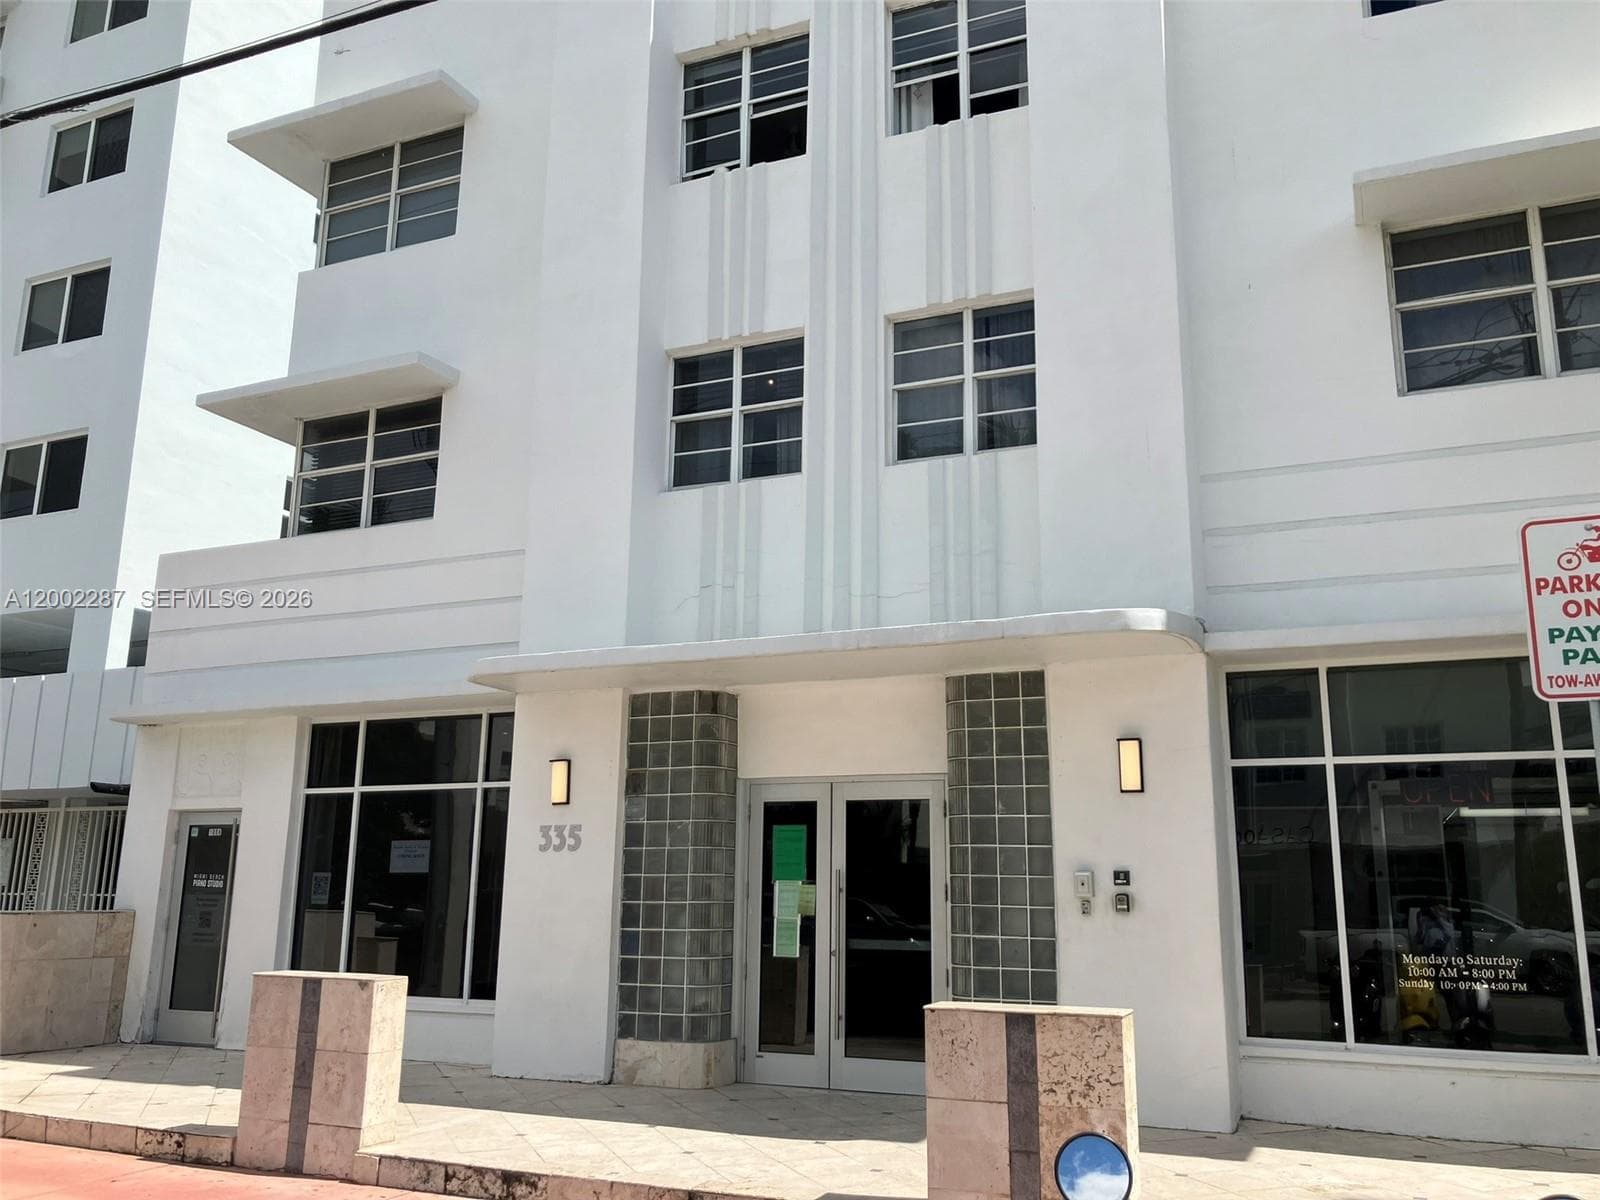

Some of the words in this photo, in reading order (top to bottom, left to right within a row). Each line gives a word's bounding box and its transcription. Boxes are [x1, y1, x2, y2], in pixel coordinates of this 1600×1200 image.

[1535, 573, 1600, 596] PARK
[1562, 598, 1600, 618] ON
[1548, 625, 1600, 644] PAY
[1562, 648, 1600, 666] PA
[538, 824, 582, 853] 335
[192, 879, 207, 887] PIANO
[207, 879, 224, 888] STUDIO
[1402, 953, 1448, 967] Monday
[1451, 955, 1464, 965] to
[1466, 954, 1523, 969] Saturday:
[1408, 966, 1436, 977] 10:00
[1438, 967, 1458, 978] AM
[1471, 968, 1495, 979] 8:00
[1498, 969, 1517, 980] PM
[1398, 978, 1435, 990] Sunday
[1490, 982, 1510, 991] 4:00
[1511, 982, 1528, 992] PM
